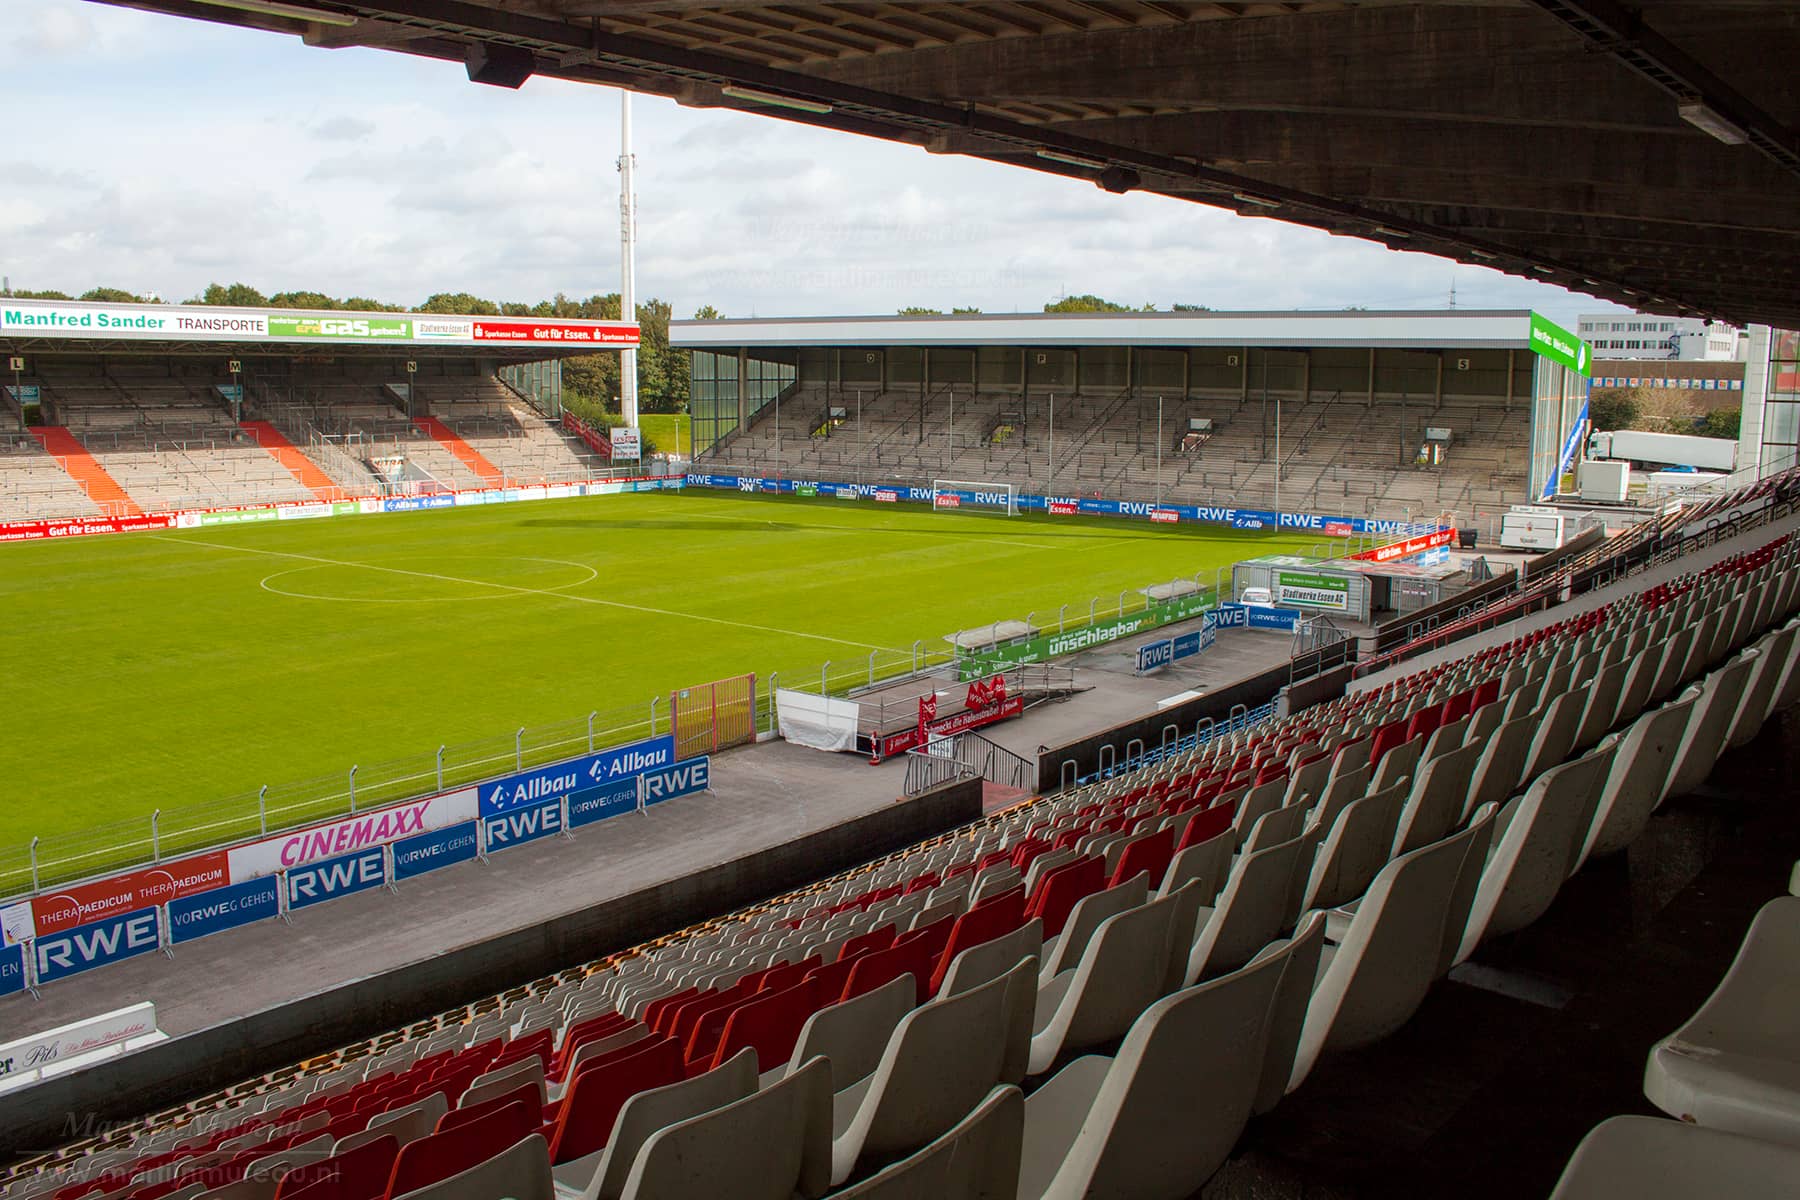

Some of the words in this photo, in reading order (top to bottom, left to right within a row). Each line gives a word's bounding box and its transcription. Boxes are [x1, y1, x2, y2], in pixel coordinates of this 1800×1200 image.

[5, 310, 92, 328] Manfred
[98, 313, 166, 329] Sander
[176, 317, 264, 332] TRANSPORTE
[512, 330, 528, 338] Essen
[533, 328, 549, 338] Gut
[550, 328, 563, 339] für
[564, 328, 591, 340] Essen.
[687, 474, 712, 485] RWE
[975, 491, 1008, 505] RWE
[1050, 503, 1073, 515] Essen.
[1119, 502, 1156, 515] RWE
[1197, 507, 1237, 521] RWE
[1280, 513, 1323, 528] RWE
[25, 531, 44, 539] Essen
[48, 526, 68, 536] Gut
[68, 524, 83, 535] für
[84, 523, 116, 534] Essen.
[1282, 588, 1317, 601] Stadtwerke
[1317, 591, 1334, 602] Essen
[1334, 593, 1344, 603] AG
[1049, 617, 1141, 656] unschlagbar
[1143, 644, 1170, 666] RWE
[609, 749, 667, 778] Allbau
[512, 773, 577, 804] Allbau
[645, 762, 708, 800] RWE
[570, 793, 612, 815] VORWEG
[612, 788, 636, 804] GEHEN
[280, 801, 431, 867] CINEMAXX
[486, 803, 562, 846] RWE
[397, 843, 447, 865] VORWEG
[448, 835, 475, 852] GEHEN
[139, 868, 223, 899] THERAPAEDICUM
[290, 852, 384, 902] RWE
[40, 892, 133, 925] THERAPAEDICUM
[174, 900, 238, 926] VORWEG
[240, 890, 275, 909] GEHEN
[36, 913, 158, 976] RWE
[22, 1040, 60, 1068] Pils
